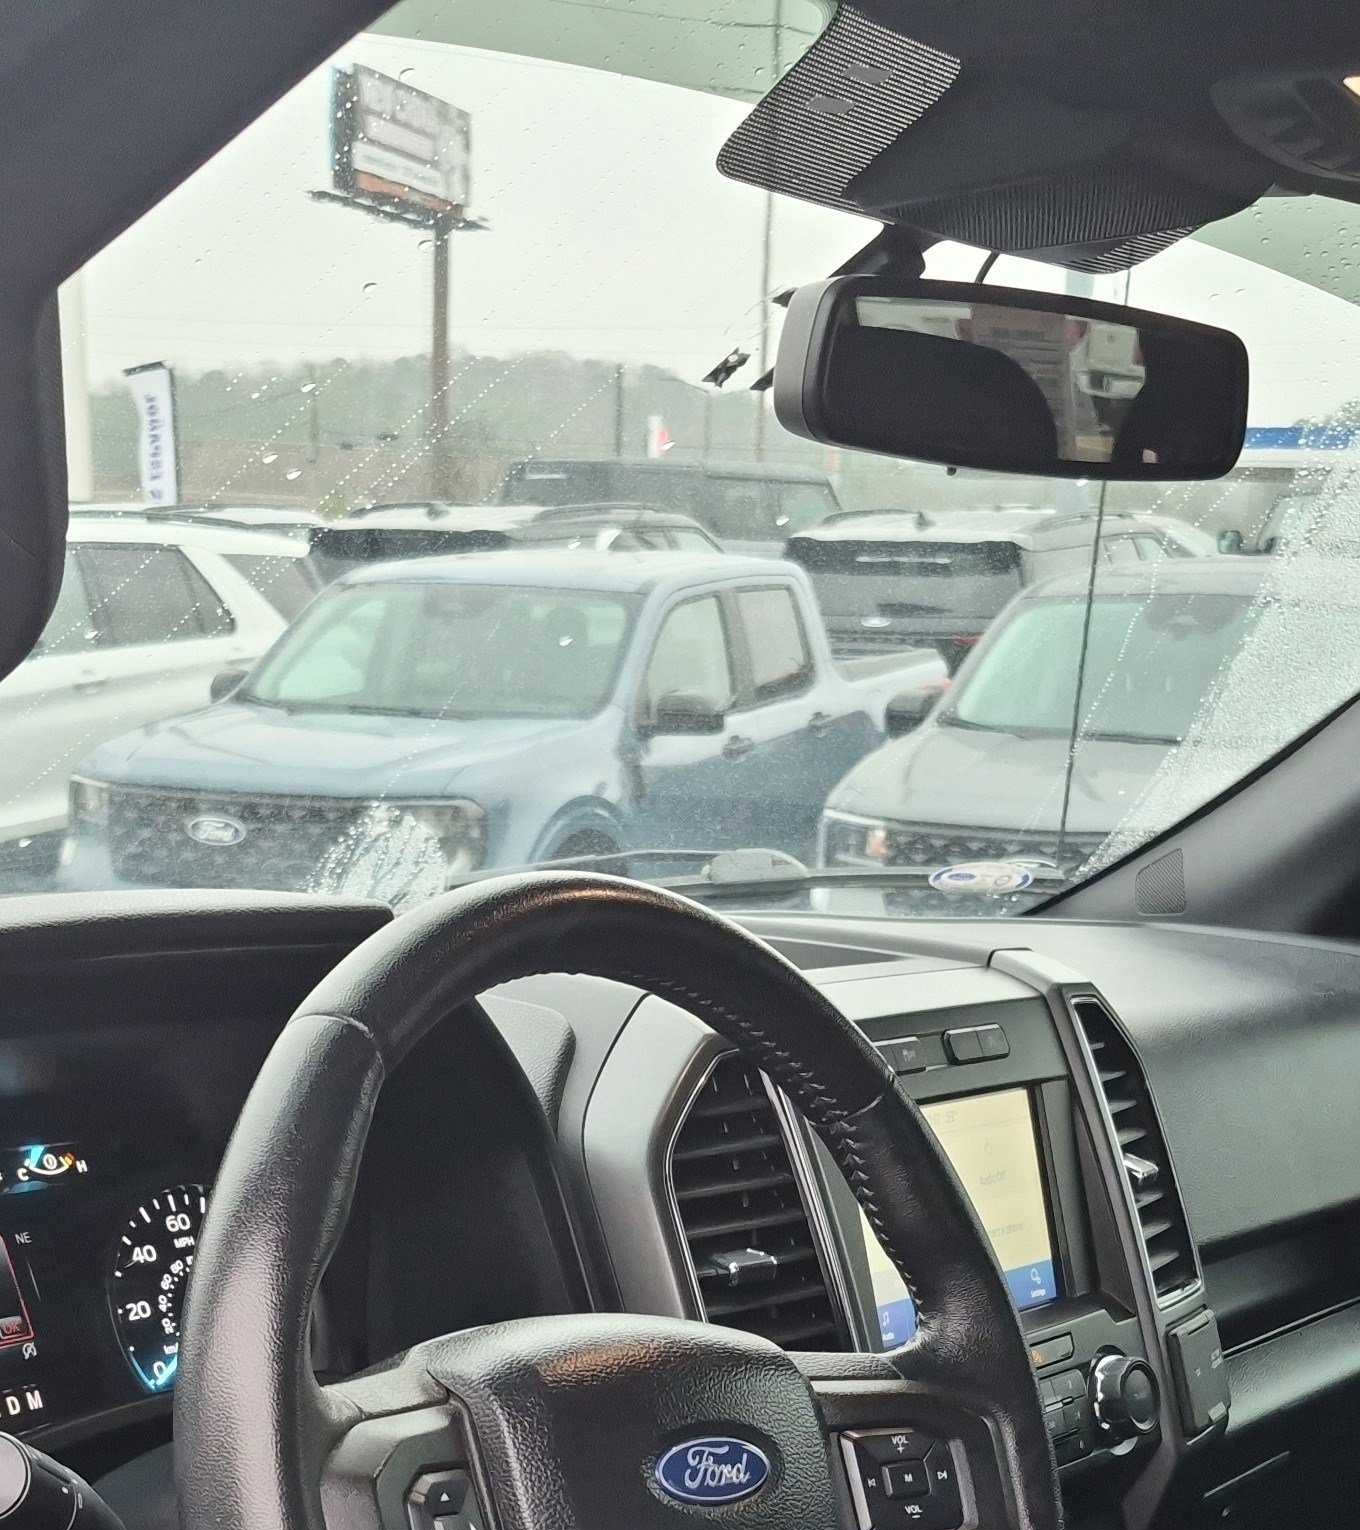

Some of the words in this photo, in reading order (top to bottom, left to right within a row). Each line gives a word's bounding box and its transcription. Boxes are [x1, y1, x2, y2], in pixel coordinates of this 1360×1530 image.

[17, 1167, 31, 1181] C
[75, 1159, 89, 1173] H
[165, 1213, 191, 1232] 60
[14, 1231, 32, 1245] NE
[173, 1235, 195, 1249] MPH
[132, 1244, 157, 1263] 40
[125, 1300, 151, 1321] 20
[158, 1294, 168, 1313] 40
[161, 1317, 174, 1335] 20
[5, 1395, 21, 1415] D
[25, 1389, 44, 1411] M
[891, 1435, 909, 1445] VOL
[684, 1444, 751, 1491] Ford
[903, 1473, 914, 1483] M
[904, 1504, 923, 1515] VOL
